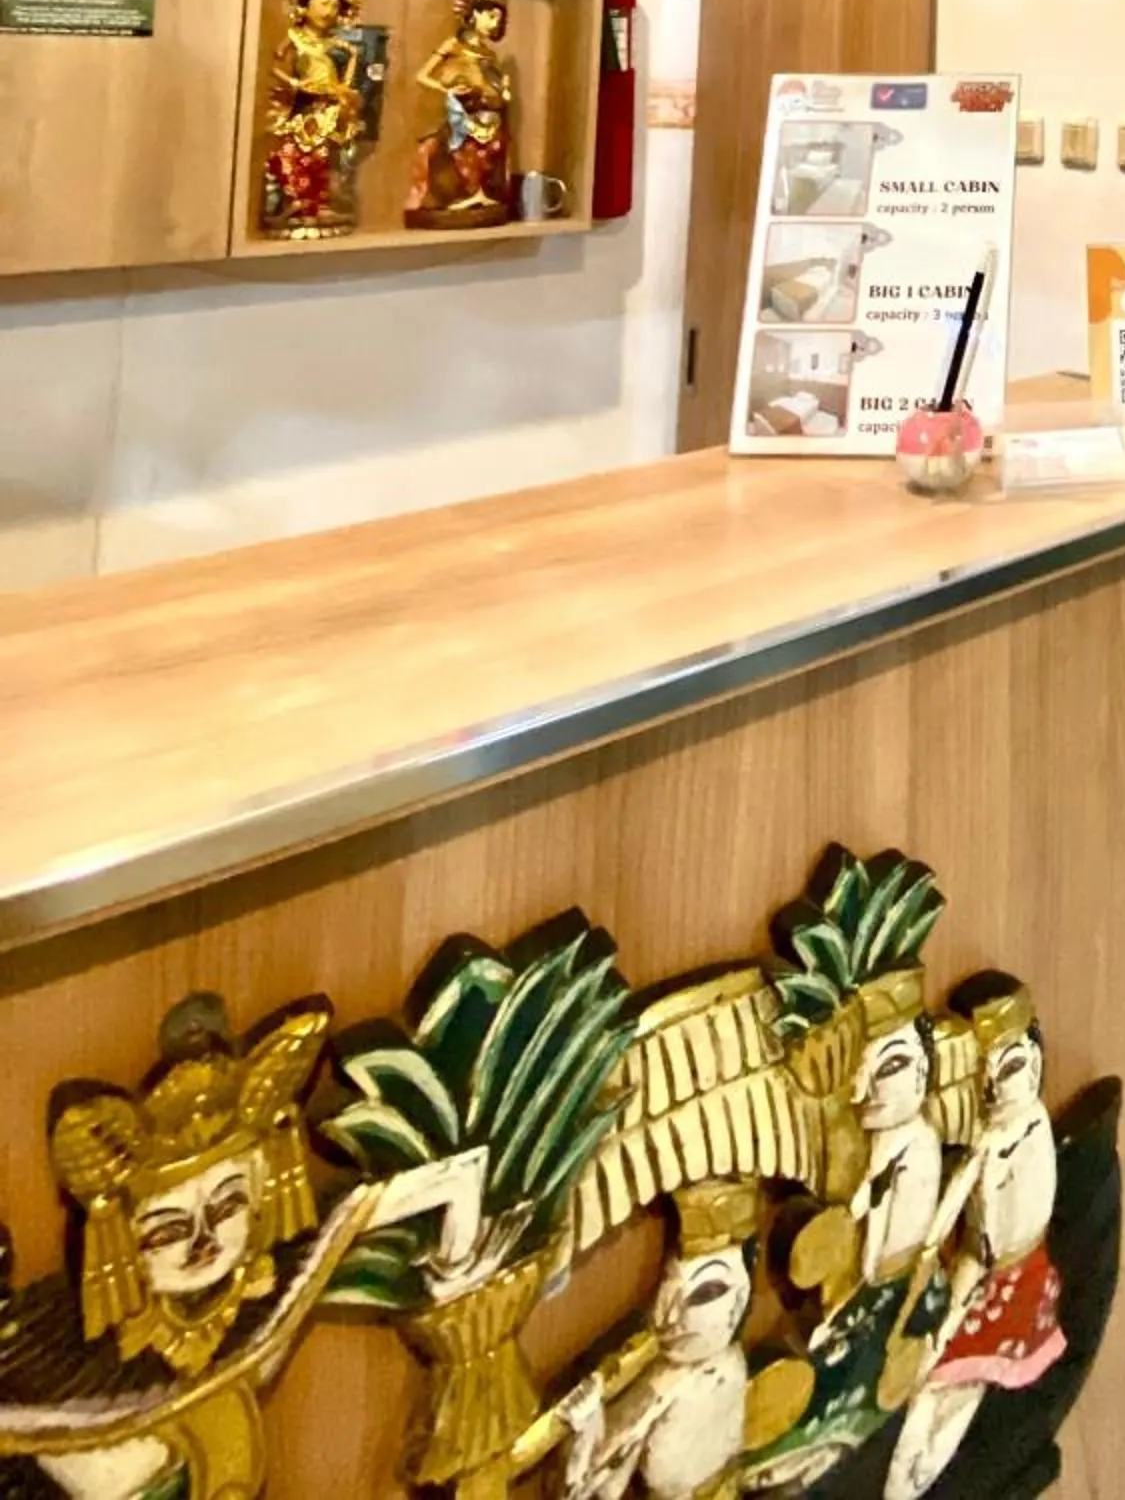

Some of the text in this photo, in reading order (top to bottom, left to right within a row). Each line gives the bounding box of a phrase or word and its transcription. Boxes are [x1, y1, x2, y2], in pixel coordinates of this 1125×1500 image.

[880, 180, 1000, 194] SMALL CABIN
[876, 202, 929, 217] capacity
[941, 202, 949, 214] 2
[951, 204, 995, 217] person
[868, 285, 901, 299] BIG
[865, 307, 921, 323] capacity
[860, 397, 893, 411] BIG
[899, 397, 909, 411] 2
